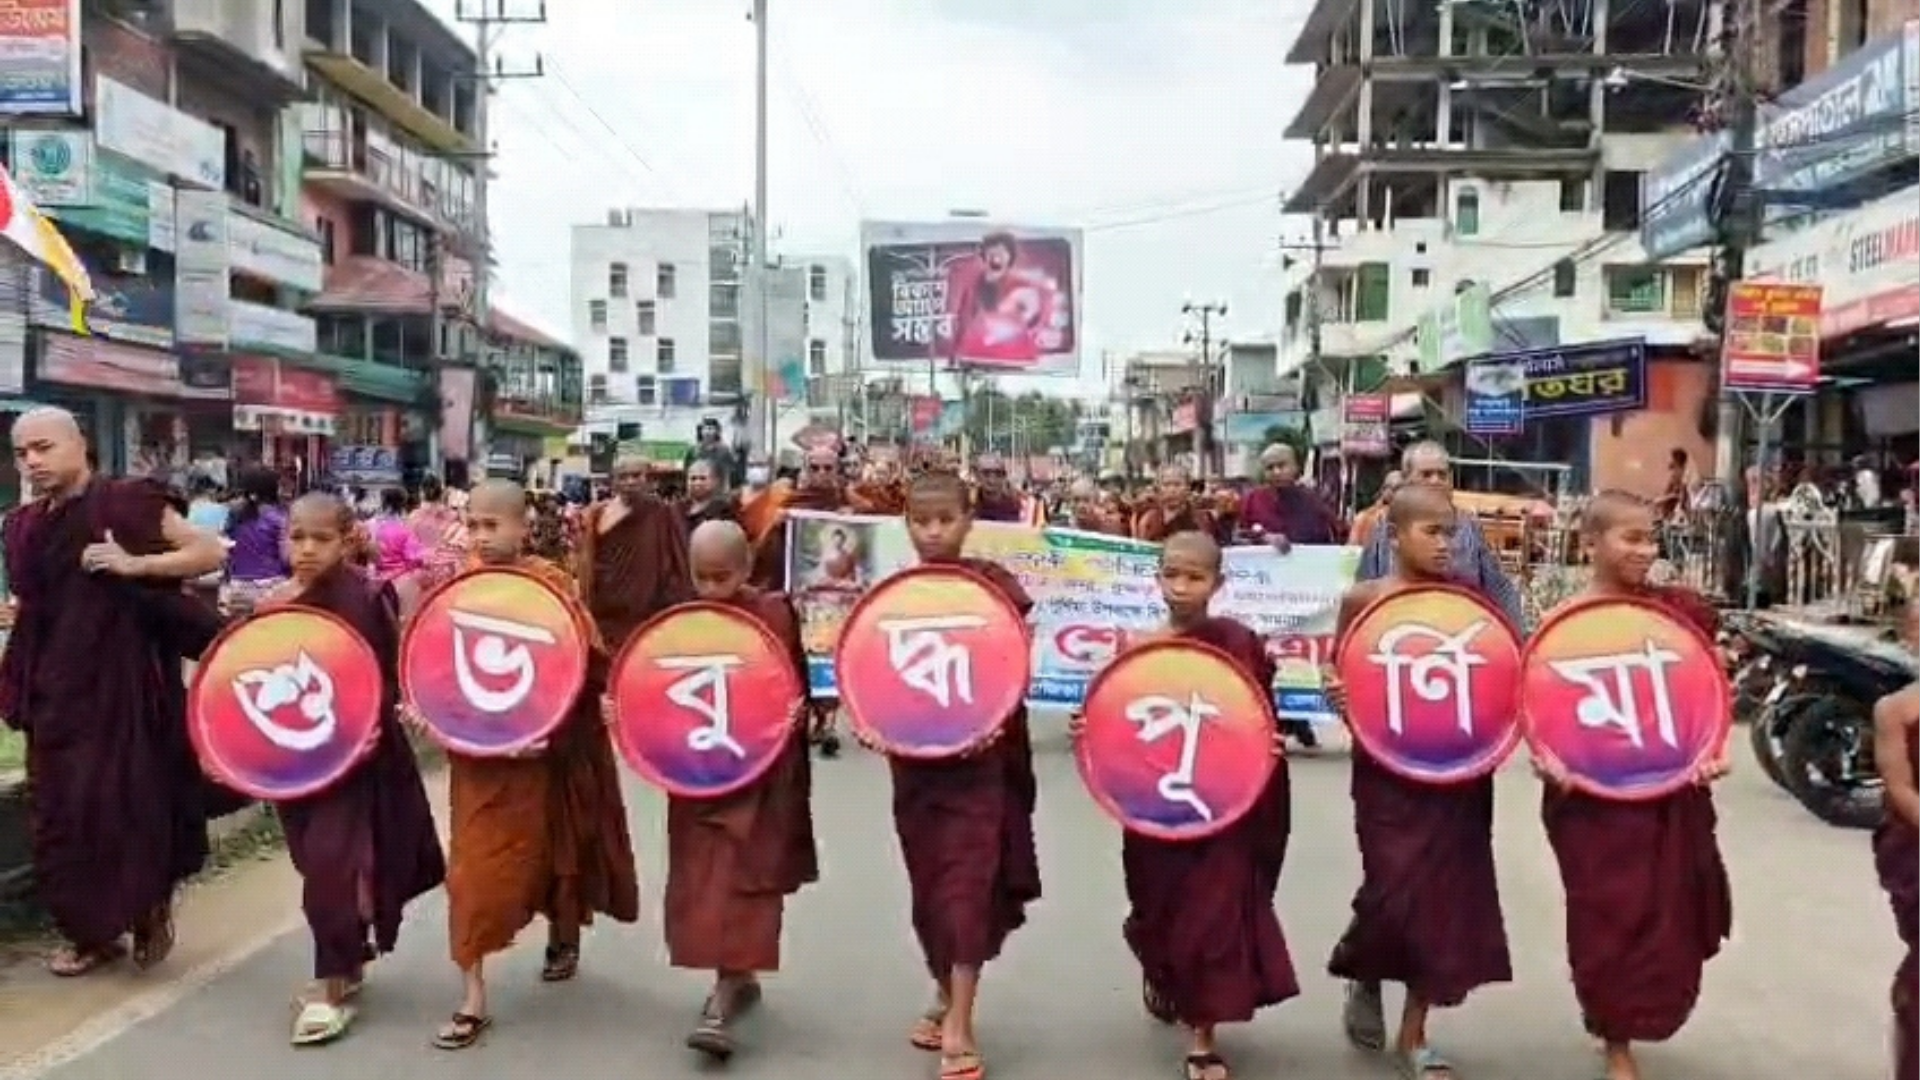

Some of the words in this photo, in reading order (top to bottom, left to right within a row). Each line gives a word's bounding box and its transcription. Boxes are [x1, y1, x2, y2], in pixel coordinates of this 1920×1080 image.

[233, 645, 336, 750] শু
[448, 607, 557, 713] ভ
[653, 655, 746, 760] বু
[1367, 620, 1491, 738] র্ণি
[1547, 639, 1684, 749] মা
[1124, 690, 1222, 823] পূ
